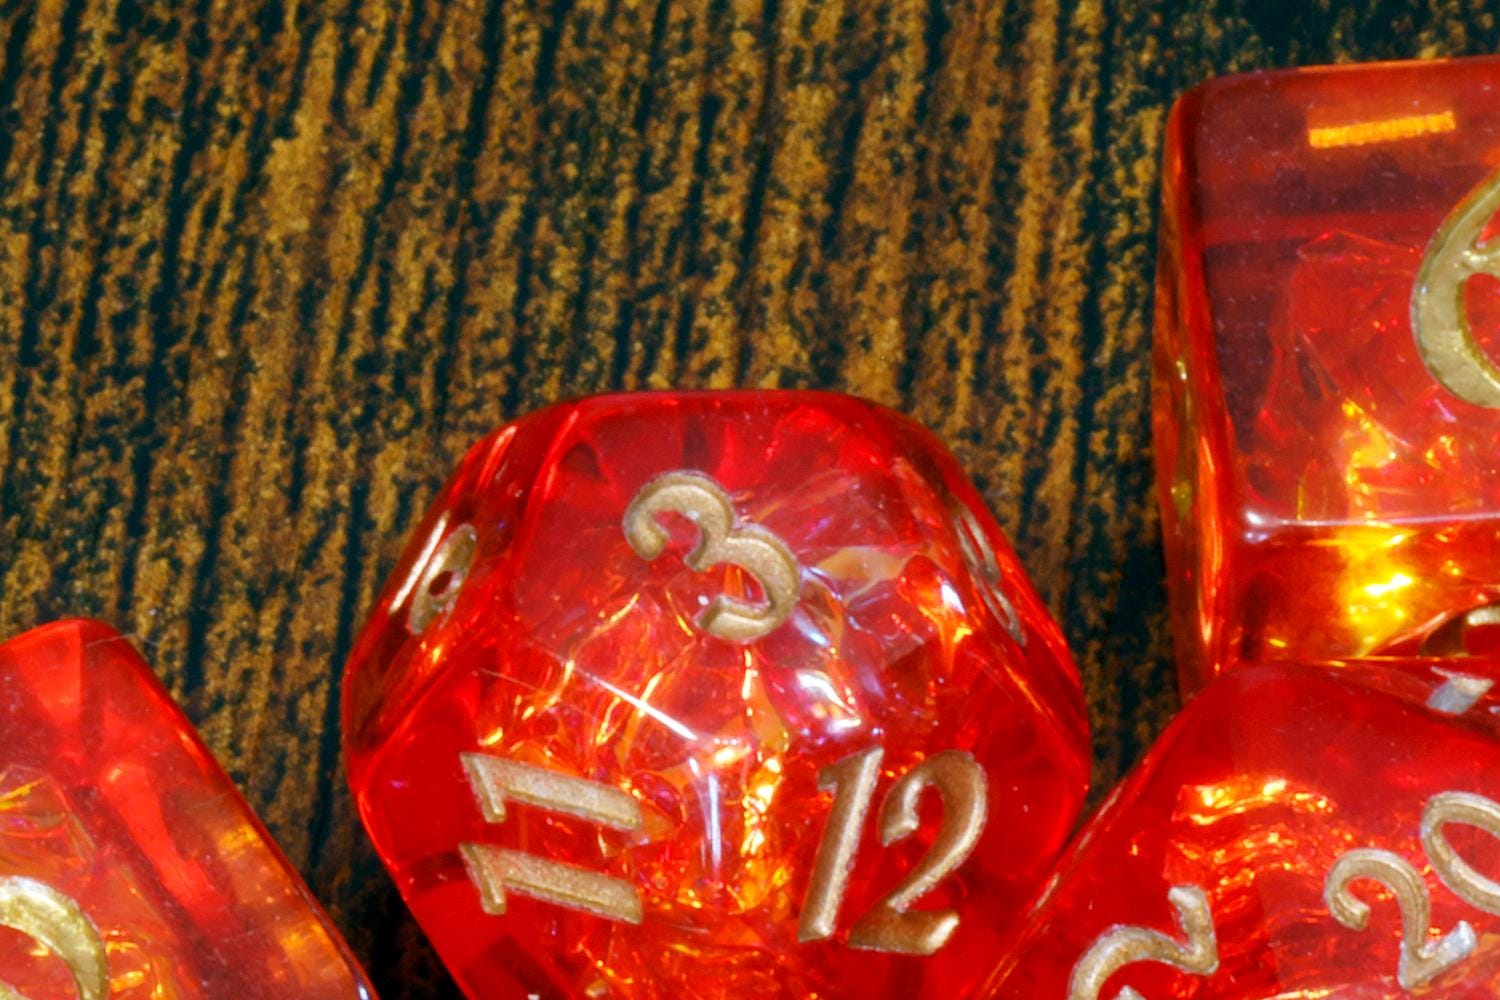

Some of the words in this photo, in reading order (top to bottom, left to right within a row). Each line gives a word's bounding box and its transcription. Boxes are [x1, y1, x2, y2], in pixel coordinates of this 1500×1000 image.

[622, 470, 798, 643] 3
[459, 752, 644, 925] 11
[800, 746, 988, 955] 12
